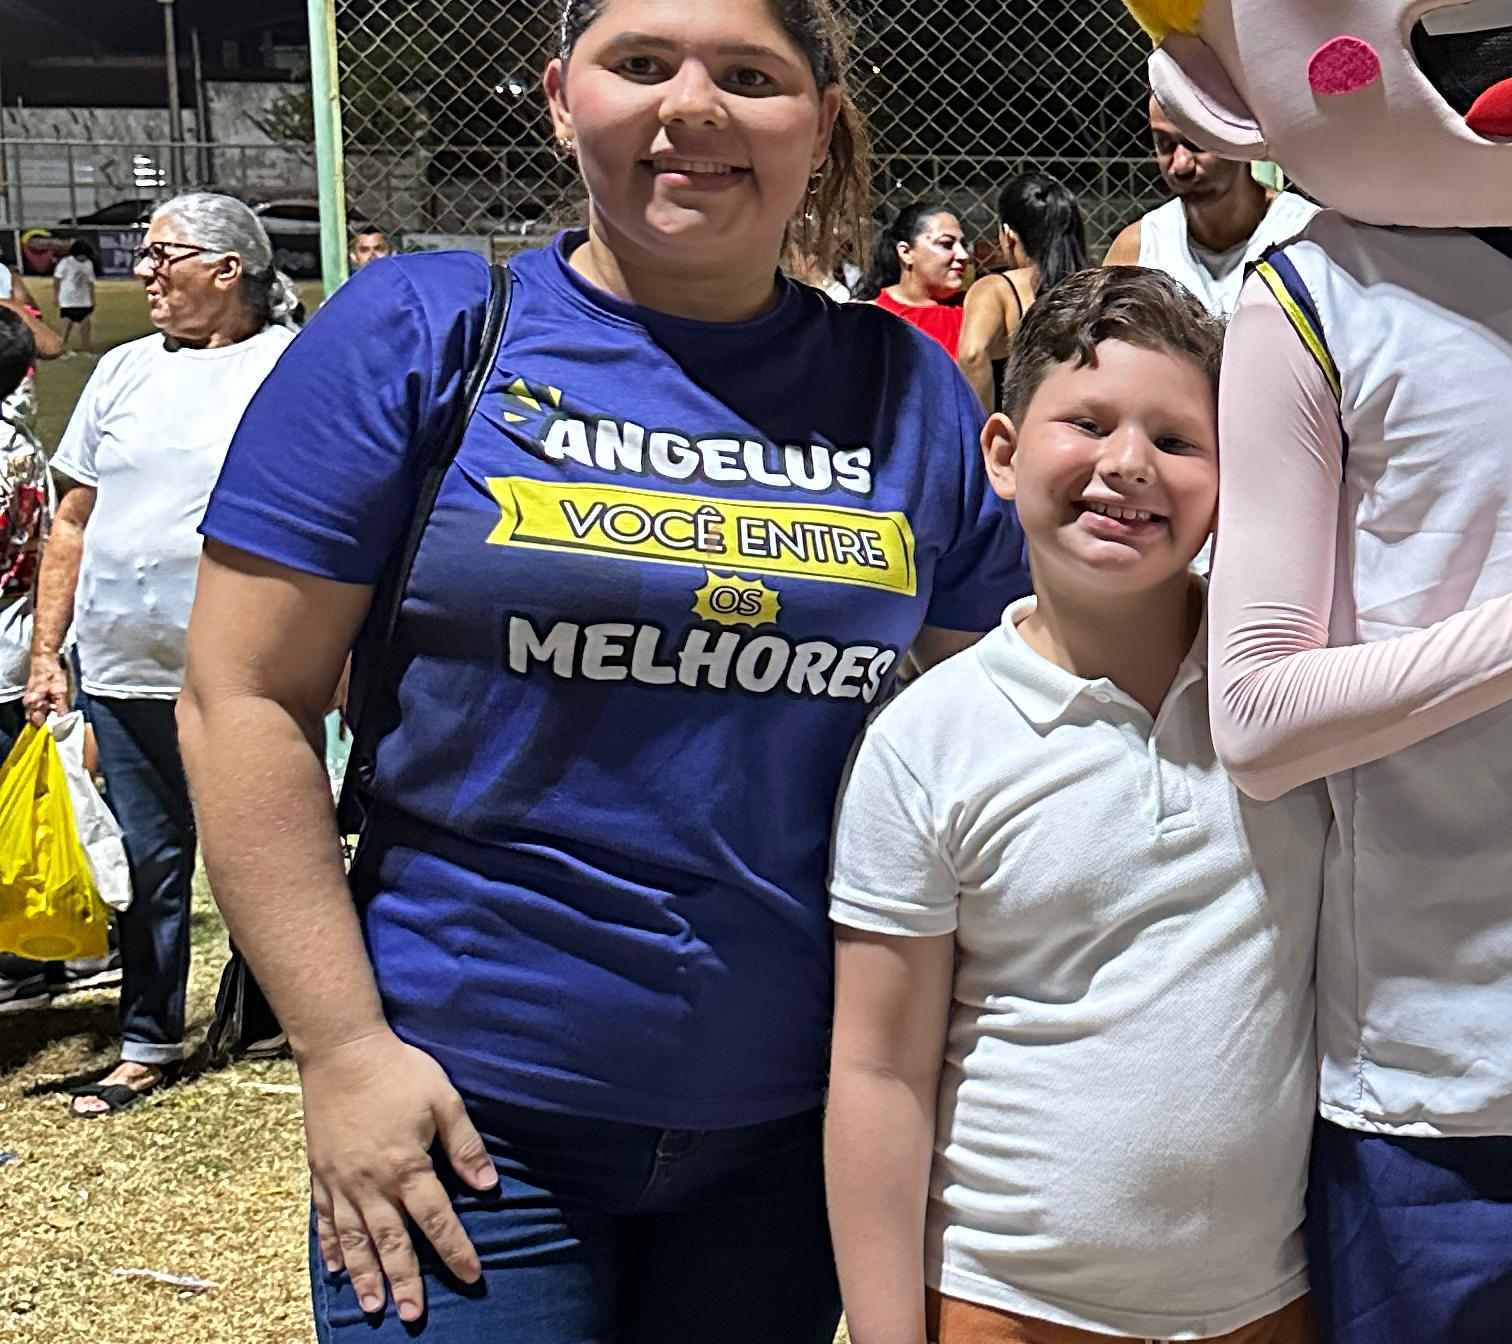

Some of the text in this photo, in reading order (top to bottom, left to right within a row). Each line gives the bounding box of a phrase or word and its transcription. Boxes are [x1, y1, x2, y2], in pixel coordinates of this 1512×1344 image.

[540, 417, 873, 495] ANGELUS
[560, 498, 889, 569] VOCÊ ENTRE
[708, 585, 764, 617] OS
[507, 615, 898, 705] MELHORES
